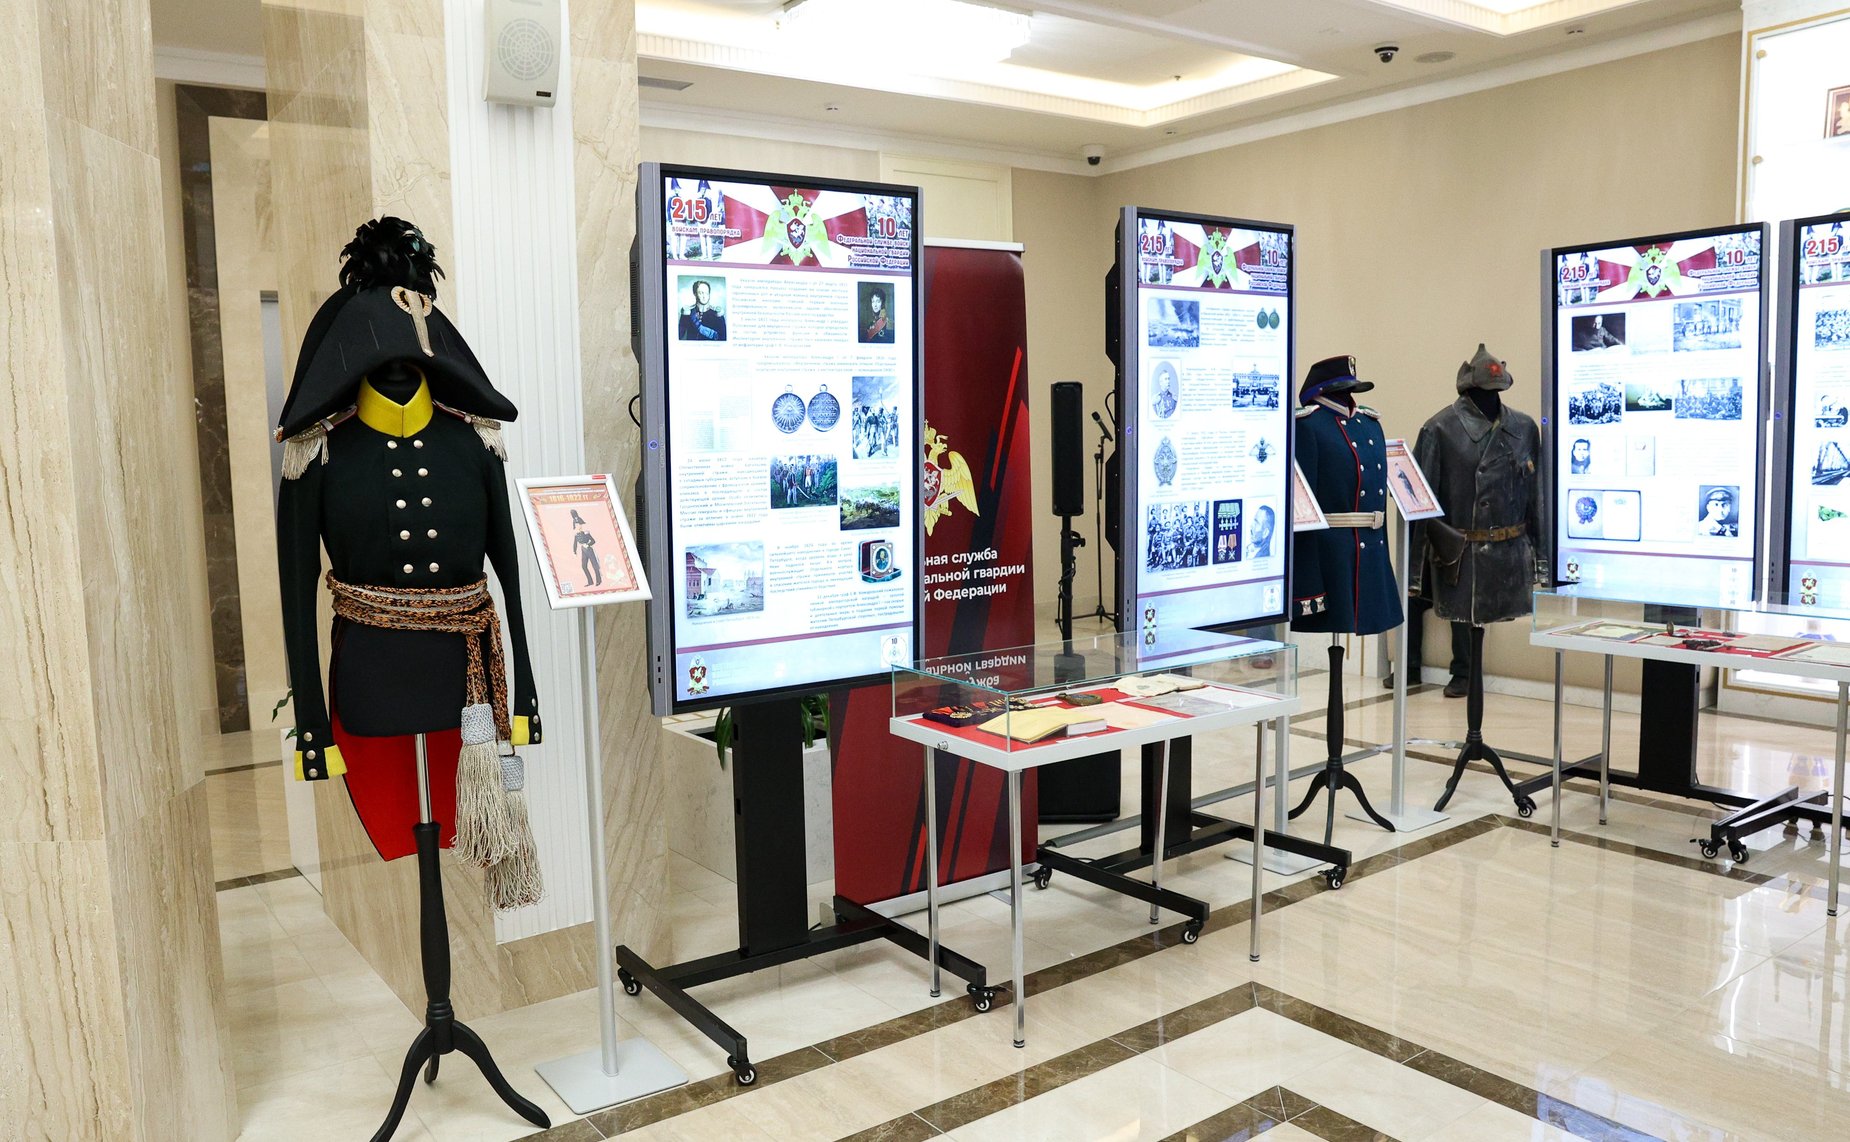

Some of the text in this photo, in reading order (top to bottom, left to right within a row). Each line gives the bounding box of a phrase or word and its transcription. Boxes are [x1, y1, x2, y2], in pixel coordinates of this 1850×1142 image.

[672, 197, 721, 221] 215 ЛЕТ
[878, 217, 896, 237] 10
[1142, 234, 1163, 252] 215
[1807, 238, 1838, 255] 215
[1267, 250, 1278, 265] 10
[1726, 249, 1743, 265] 10
[1562, 265, 1585, 280] 215
[951, 547, 998, 565] служба
[973, 564, 1025, 579] гвардии
[933, 583, 1007, 601] Федерации
[891, 637, 898, 645] 10
